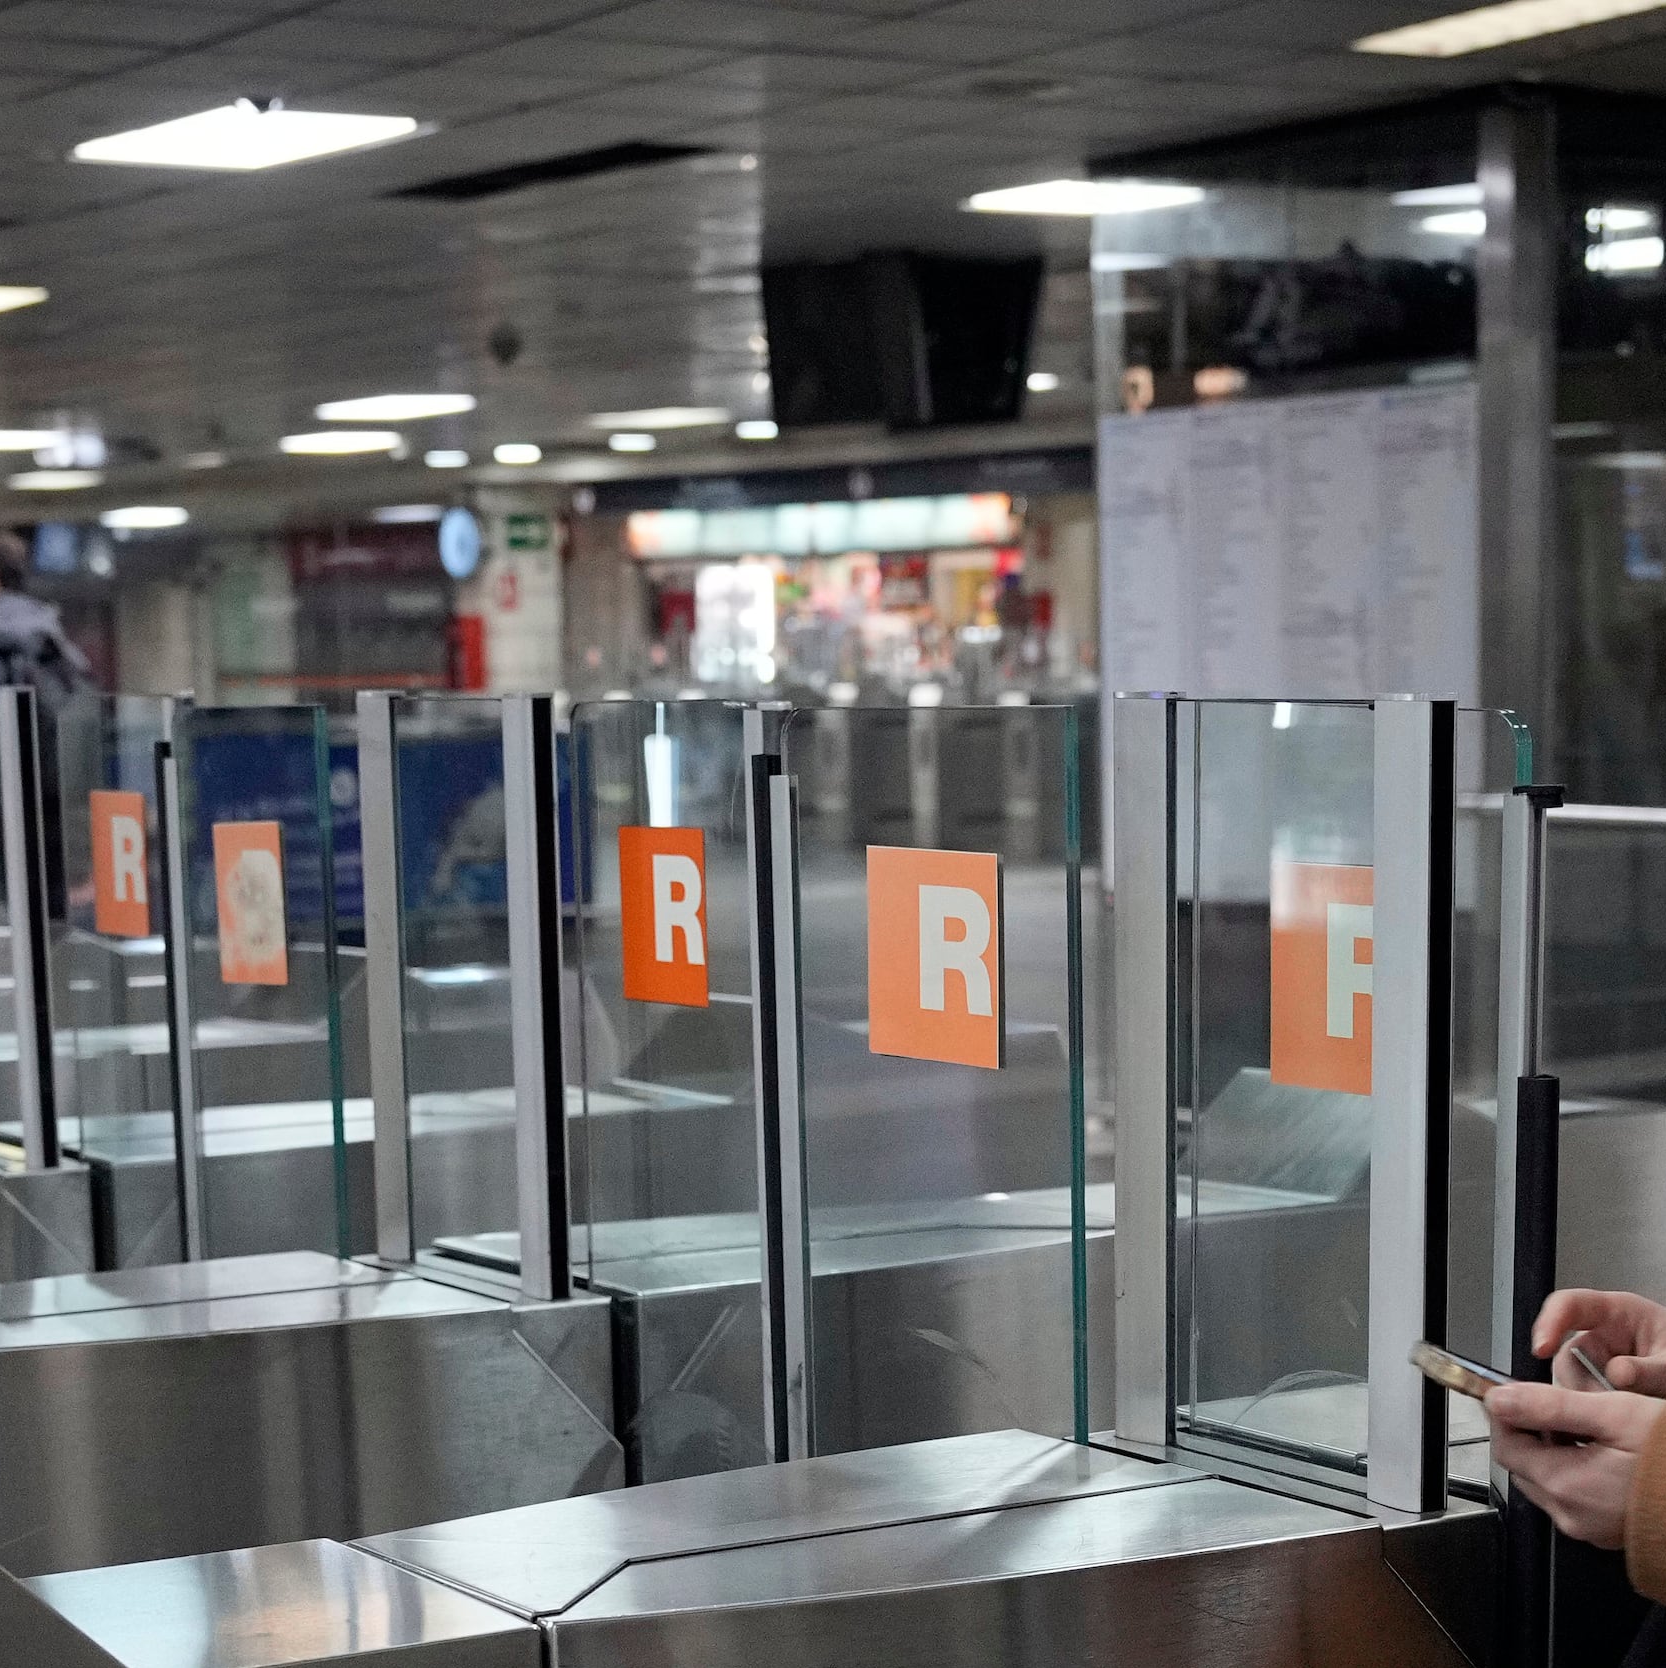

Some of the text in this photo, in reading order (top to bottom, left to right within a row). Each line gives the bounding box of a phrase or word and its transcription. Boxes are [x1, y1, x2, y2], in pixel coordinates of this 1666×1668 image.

[111, 815, 146, 904] R
[652, 853, 705, 966] R
[918, 884, 994, 1018] R
